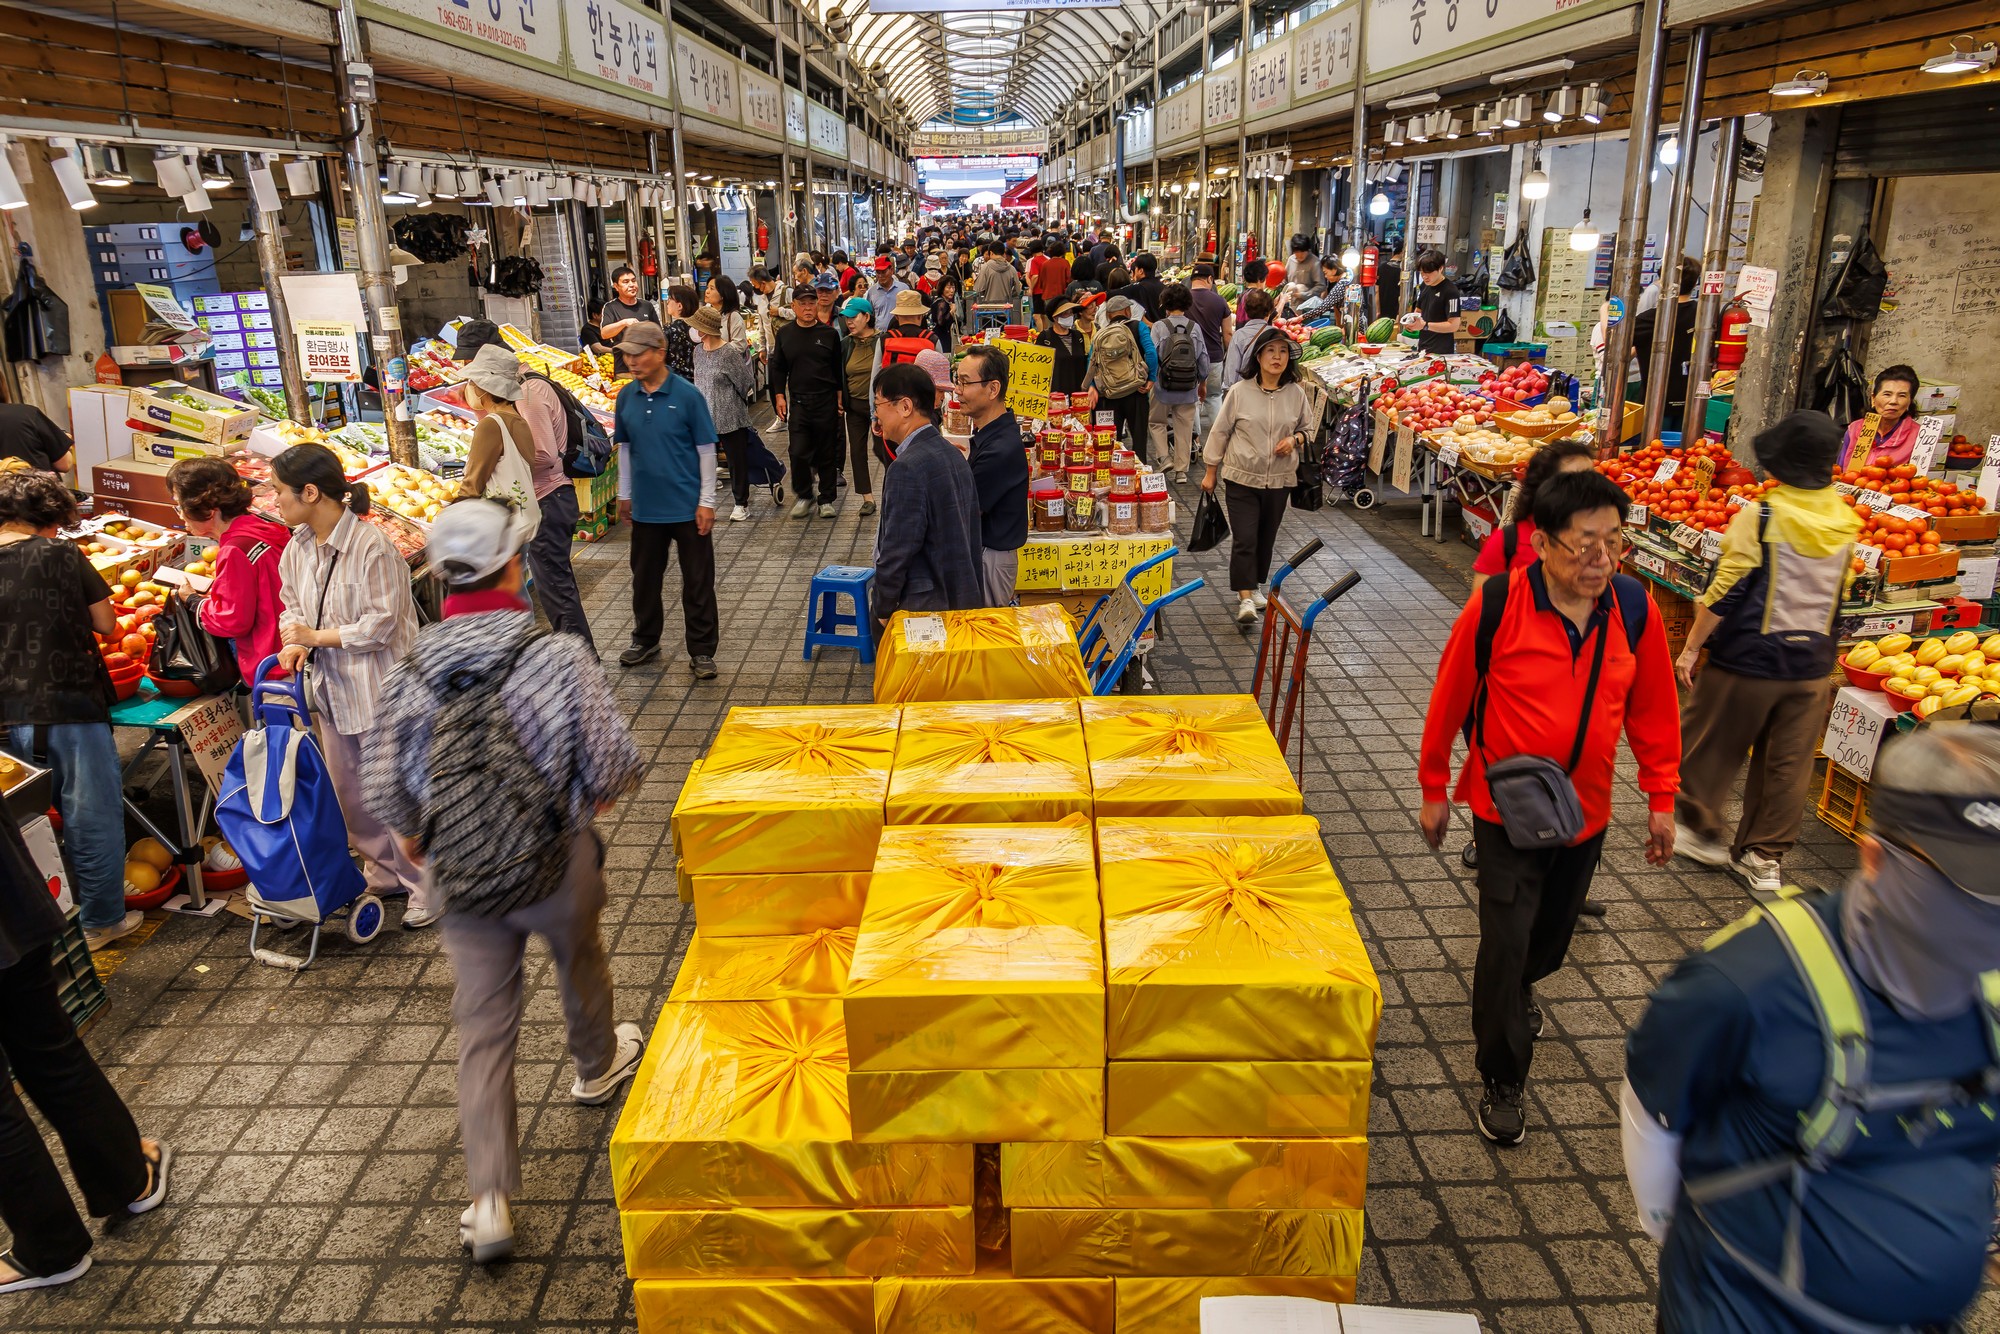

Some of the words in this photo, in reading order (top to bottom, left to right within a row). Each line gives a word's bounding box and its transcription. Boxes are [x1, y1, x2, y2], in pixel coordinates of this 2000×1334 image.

[587, 0, 658, 81] 한농상회
[1299, 22, 1353, 86] 칠복청과
[689, 53, 732, 109] 우성상회
[1208, 77, 1238, 119] 삼동청과
[1250, 51, 1287, 102] 장군상회
[306, 340, 349, 353] 환급행사
[308, 354, 351, 367] 참여점포
[1069, 543, 1120, 558] 오징어젓
[1069, 575, 1114, 589] 배추김치
[1832, 700, 1879, 744] 성주꿀참외
